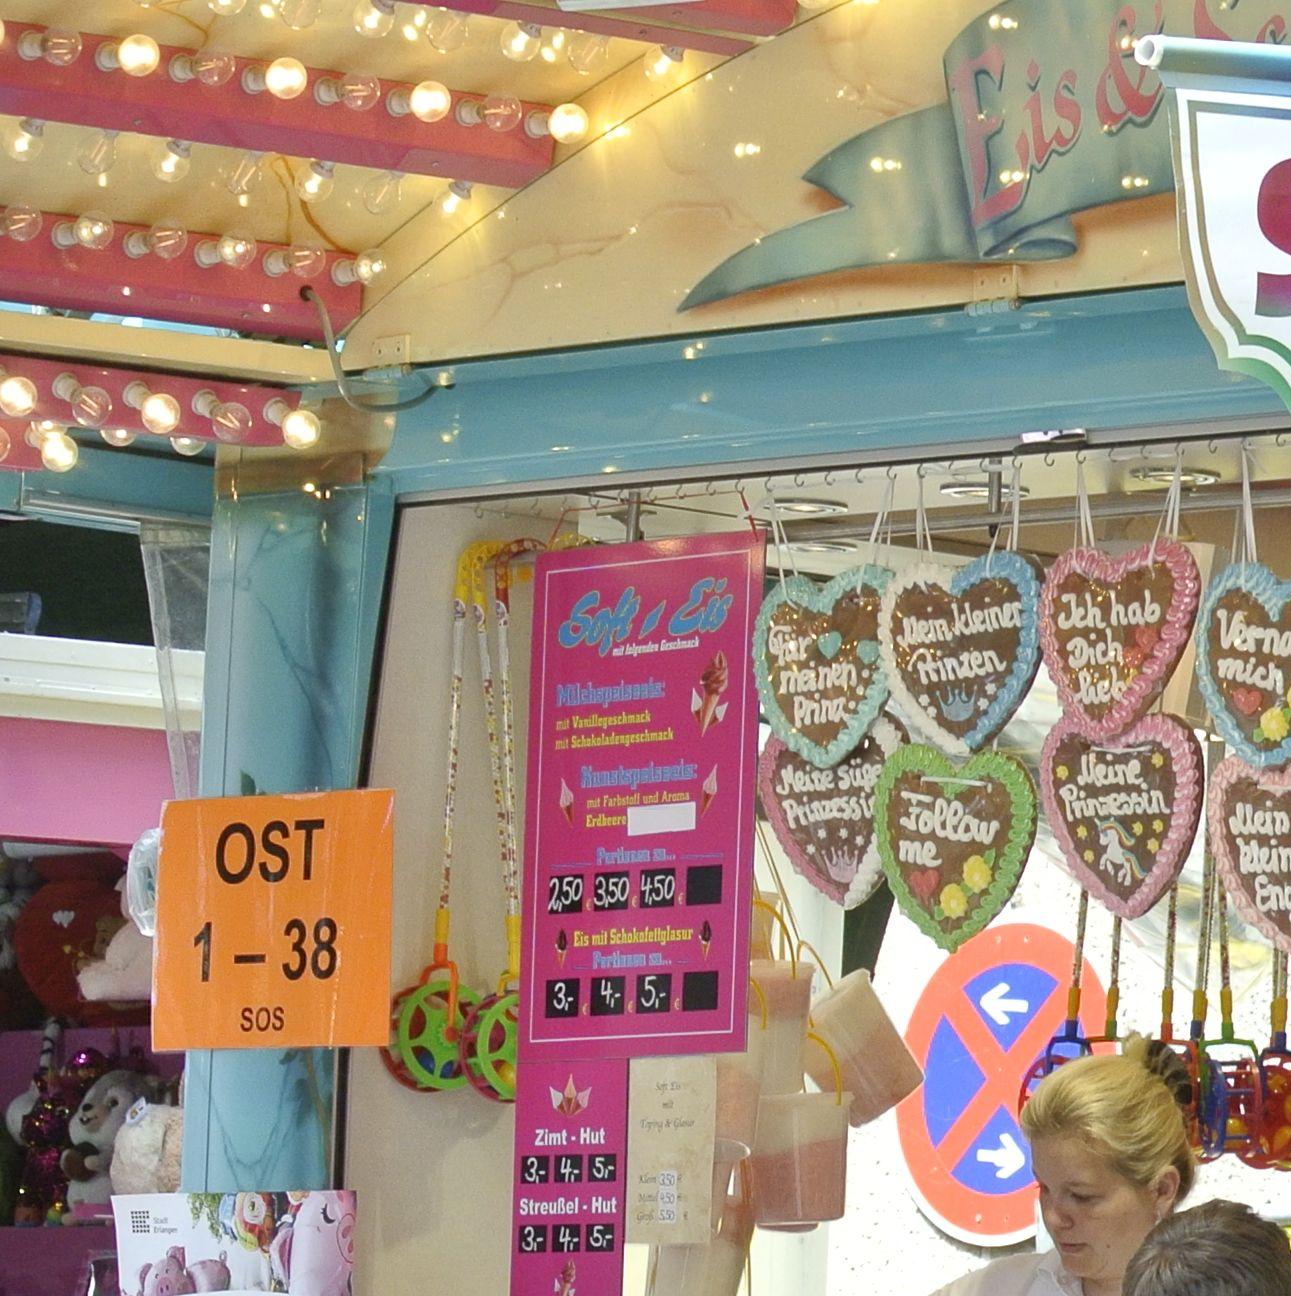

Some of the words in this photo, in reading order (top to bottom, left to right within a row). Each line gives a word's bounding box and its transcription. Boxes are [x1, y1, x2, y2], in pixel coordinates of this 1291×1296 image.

[951, 45, 1080, 223] Eis
[559, 586, 640, 656] Soft
[669, 577, 734, 635] Eis
[896, 607, 950, 651] Mein
[950, 597, 1024, 639] kleiner
[1057, 590, 1106, 631] Ich
[1110, 590, 1161, 627] hab
[768, 625, 812, 666] Für
[1066, 632, 1124, 669] Dich
[780, 661, 858, 695] meinen
[908, 647, 1007, 687] Prinzen
[1218, 657, 1285, 696] mich
[556, 719, 570, 730] mit
[572, 710, 651, 729] Vanillegeschmack
[555, 739, 569, 750] mit
[571, 728, 674, 748] Schokoladengeschmack
[1077, 754, 1143, 787] Meine
[587, 798, 600, 808] mit
[643, 792, 659, 804] und
[662, 791, 690, 802] Aroma
[899, 791, 999, 842] Follow
[1059, 785, 1171, 823] Prinzessin
[586, 814, 627, 828] Erdbeere
[1229, 801, 1290, 837] Mein
[216, 819, 324, 884] OST
[899, 837, 942, 867] me
[548, 877, 583, 912] 2,50
[594, 876, 630, 908] 3,50
[641, 874, 675, 905] 4,50
[194, 922, 212, 982] 1
[282, 918, 337, 980] 38
[573, 931, 589, 947] Eis
[592, 930, 608, 945] mit
[610, 927, 693, 948] Schokofettglasur
[240, 1006, 285, 1032] SOS
[534, 1129, 567, 1146] Zimt
[580, 1127, 605, 1144] Hut
[592, 1157, 614, 1178] 5,-
[519, 1197, 579, 1215] Streußel
[591, 1197, 617, 1213] Hut
[590, 1226, 613, 1247] 5,-
